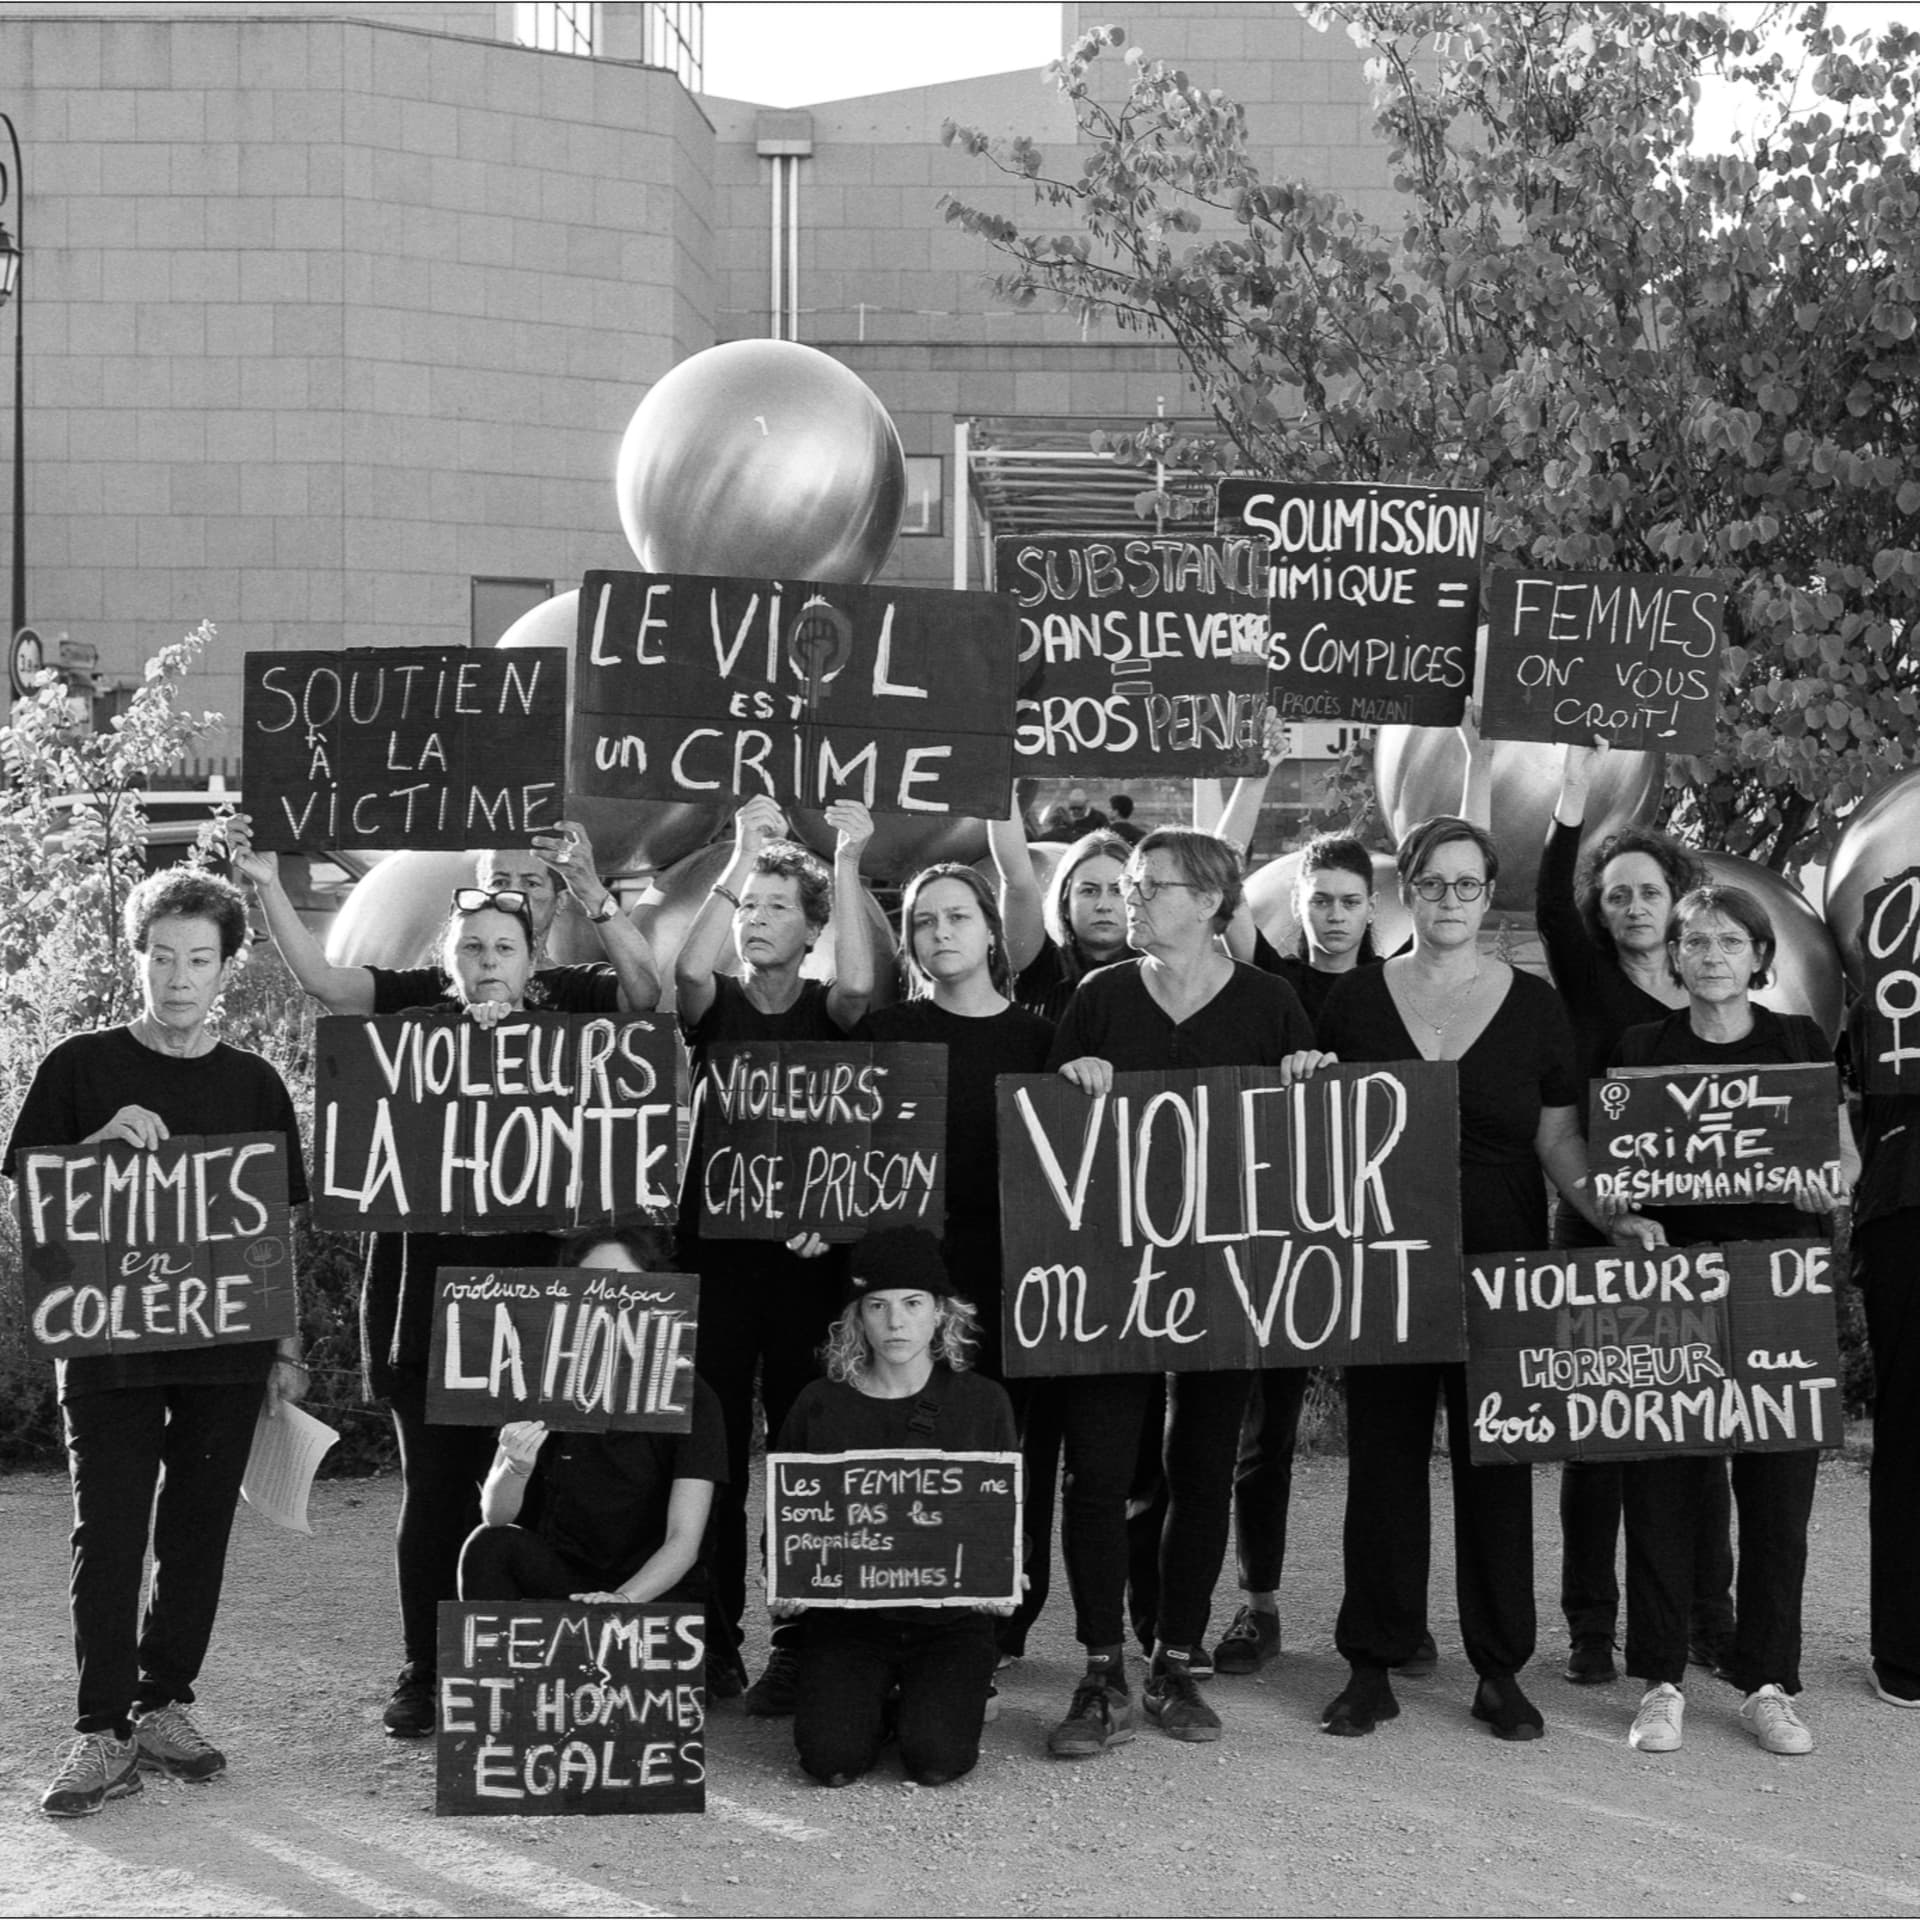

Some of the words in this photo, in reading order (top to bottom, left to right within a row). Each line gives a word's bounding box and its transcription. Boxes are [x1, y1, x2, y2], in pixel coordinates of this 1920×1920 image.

[1016, 538, 1269, 608] SUBSTANCE
[590, 582, 672, 665] LE
[711, 580, 928, 698] VIOL
[1139, 611, 1184, 658] LE
[1514, 579, 1718, 658] FEMMES
[1300, 622, 1466, 688] COMPLICES
[1517, 654, 1584, 687] ON
[1616, 661, 1709, 701] VOUS
[257, 656, 541, 733] SOUTIEN
[730, 691, 808, 720] EST
[1014, 695, 1138, 756] GROS
[387, 730, 447, 772] LA
[595, 735, 647, 775] un
[671, 725, 952, 813] CRIME
[281, 782, 556, 840] VICTIME
[363, 1018, 657, 1106] VIOLEURS
[711, 1051, 888, 1124] VIOLEURS
[1666, 1074, 1792, 1115] VIOL
[323, 1097, 411, 1216] LA
[441, 1099, 672, 1217] HONTE
[1014, 1071, 1407, 1247] VIOLEUR
[1609, 1127, 1774, 1165] CRIME
[26, 1143, 276, 1247] FEMMES
[705, 1146, 784, 1221] CASE
[799, 1145, 938, 1222] PRISON
[120, 1251, 192, 1277] en
[545, 1279, 571, 1298] de
[583, 1277, 676, 1312] Mazan
[1014, 1263, 1108, 1348] on
[1120, 1244, 1207, 1344] te
[1224, 1240, 1432, 1350] VOIT
[1472, 1253, 1730, 1311] VIOLEURS
[1770, 1247, 1833, 1298] DE
[32, 1271, 252, 1344] COLÈRE
[1556, 1305, 1719, 1349] MAZAN
[444, 1301, 528, 1402] LA
[538, 1297, 698, 1415] HONTE
[1519, 1342, 1725, 1391] HORREUR
[1747, 1349, 1818, 1369] au
[1474, 1391, 1555, 1443] bois
[1567, 1378, 1838, 1442] DORMANT
[844, 1467, 963, 1496] FEMMES
[781, 1500, 835, 1522] sont
[848, 1503, 888, 1526] PAS
[907, 1500, 943, 1526] les
[811, 1563, 843, 1588] des
[464, 1613, 706, 1671] FEMMES
[441, 1677, 516, 1733] ET
[535, 1678, 705, 1734] HOMMES
